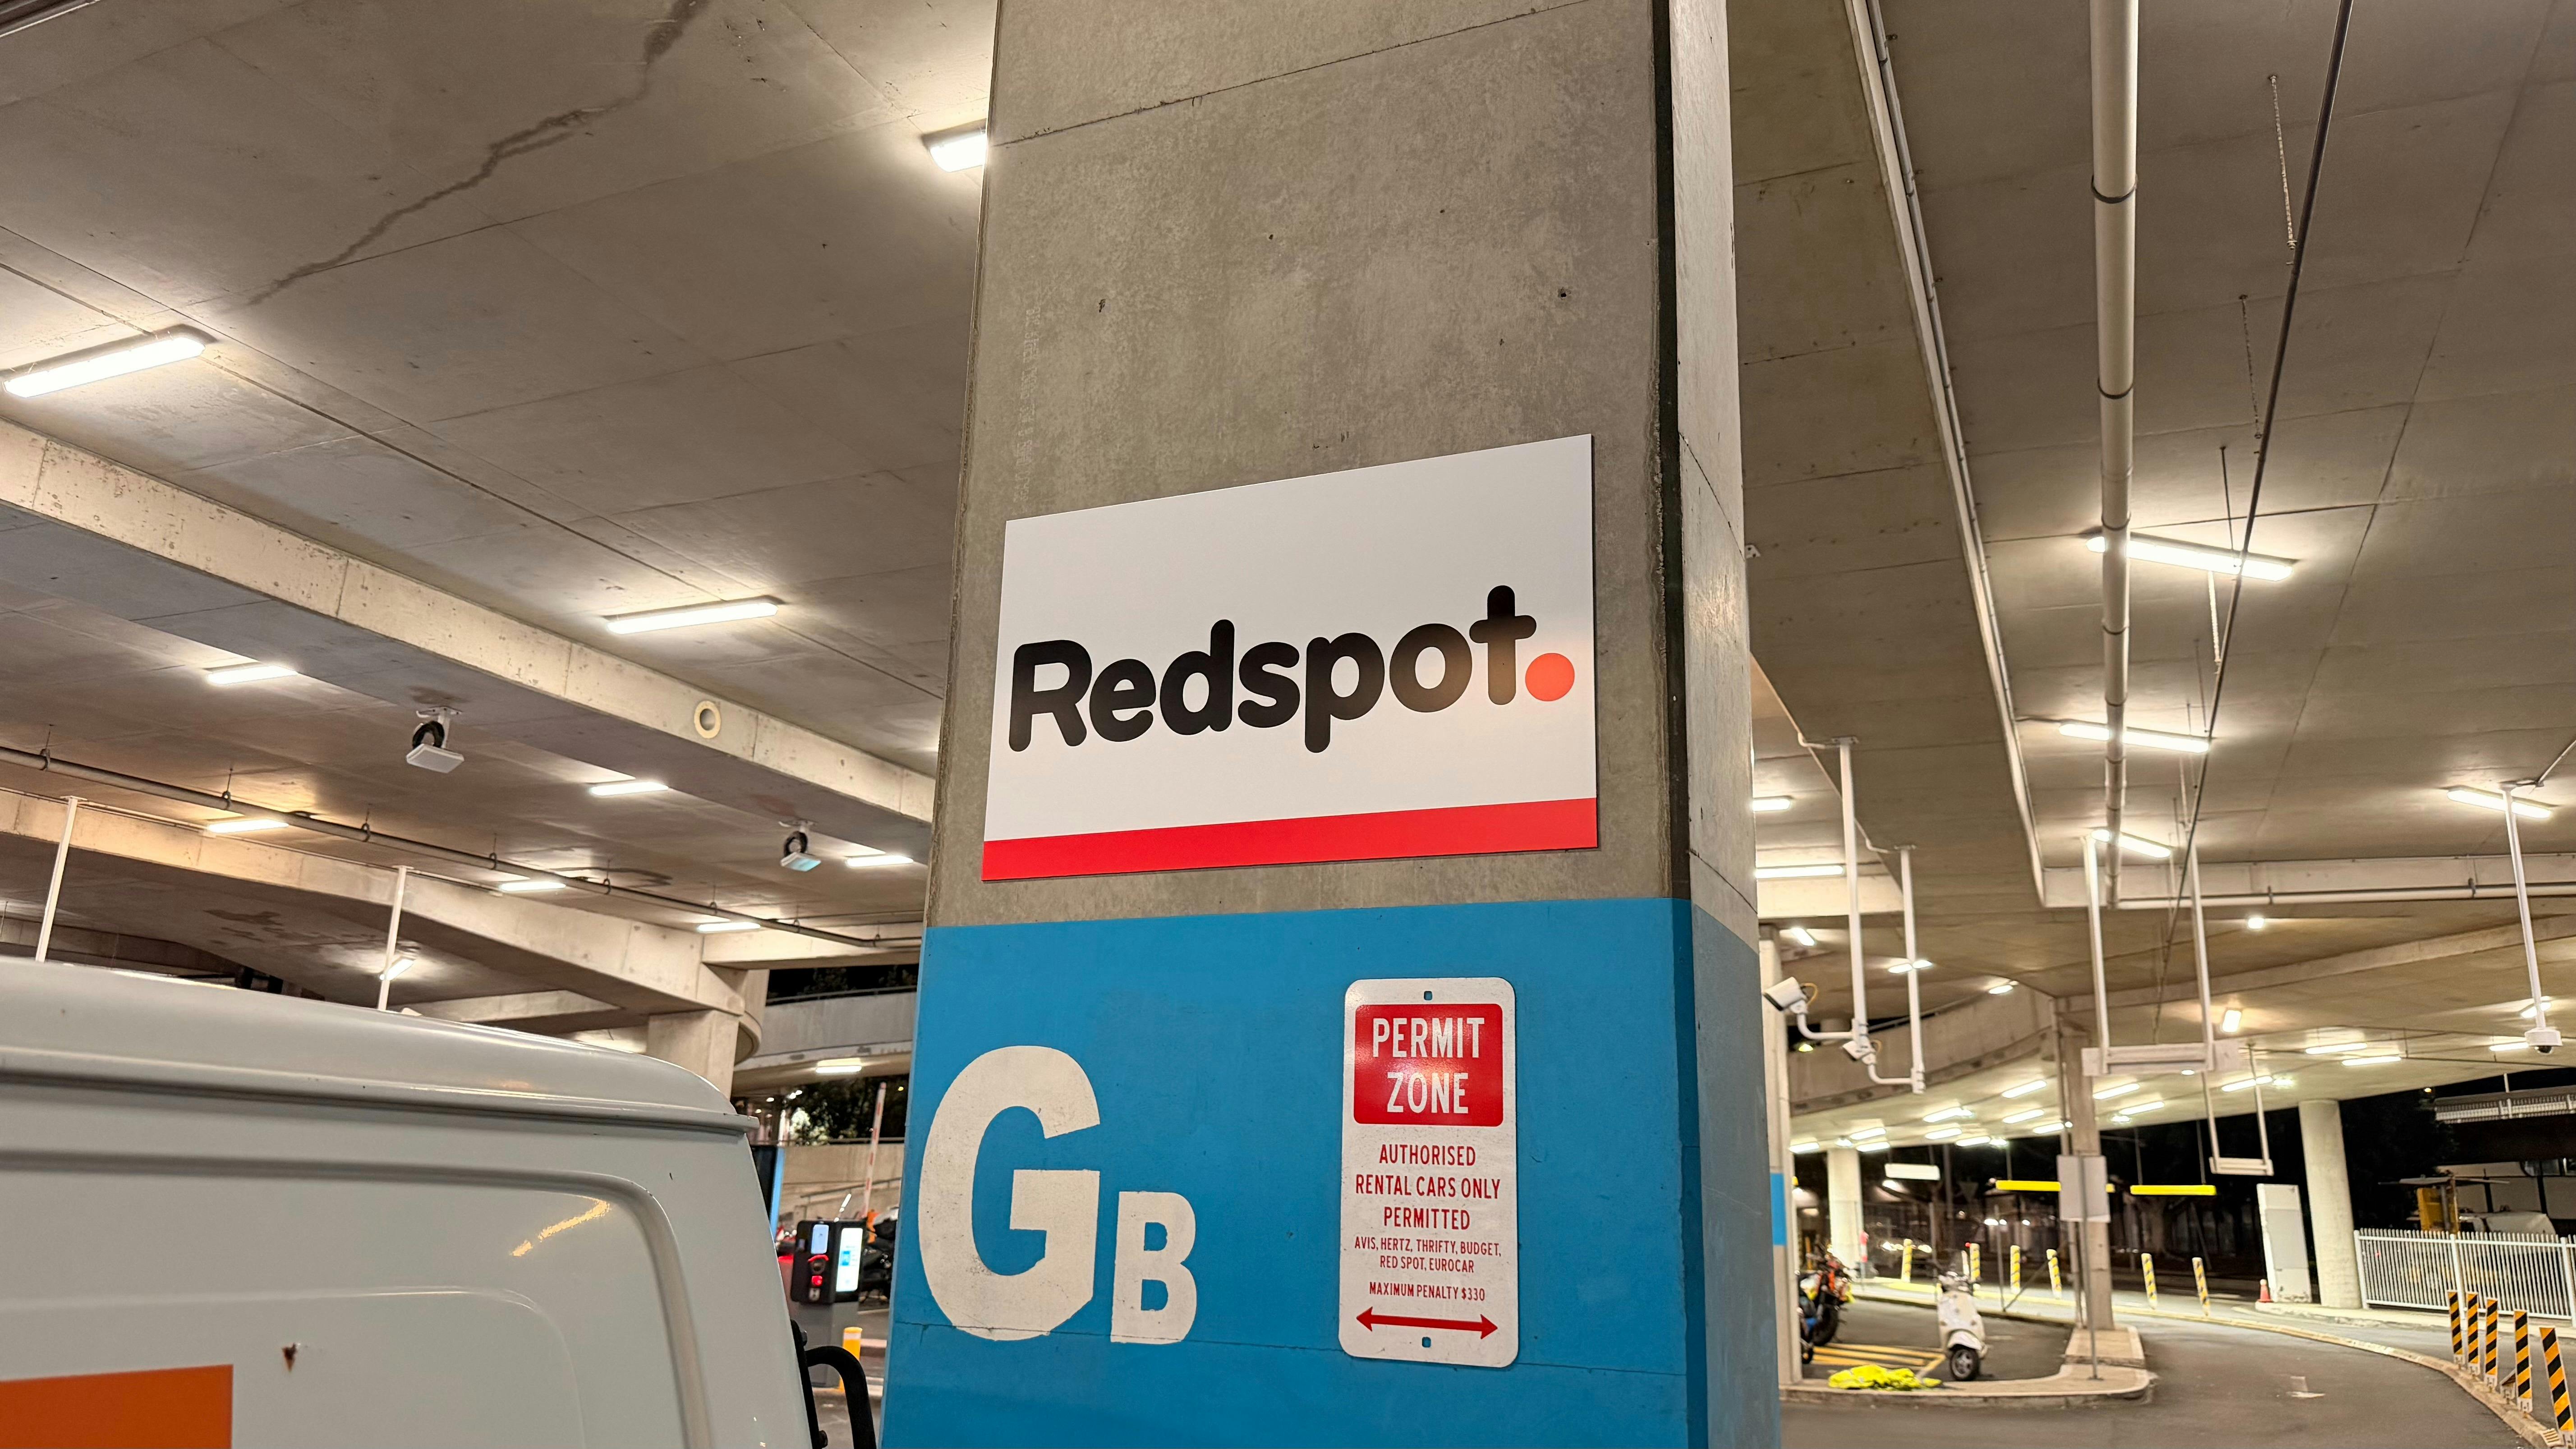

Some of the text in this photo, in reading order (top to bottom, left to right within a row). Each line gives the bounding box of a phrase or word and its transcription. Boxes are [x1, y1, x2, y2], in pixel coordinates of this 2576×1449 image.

[1373, 1017, 1485, 1058] PERMIT
[1387, 1072, 1469, 1114] ZONE
[1379, 1144, 1476, 1166] AUTHORISED
[1356, 1174, 1500, 1199] RENTAL CARS ONLY
[1384, 1206, 1471, 1231] PERMITTED
[1354, 1236, 1502, 1257] AVIS, HERTZ, THRIFTY, BUDGET,
[1380, 1255, 1474, 1273] RED SPOT, EUROCAR
[1369, 1282, 1485, 1301] MAXIMUM PENALTY $330
